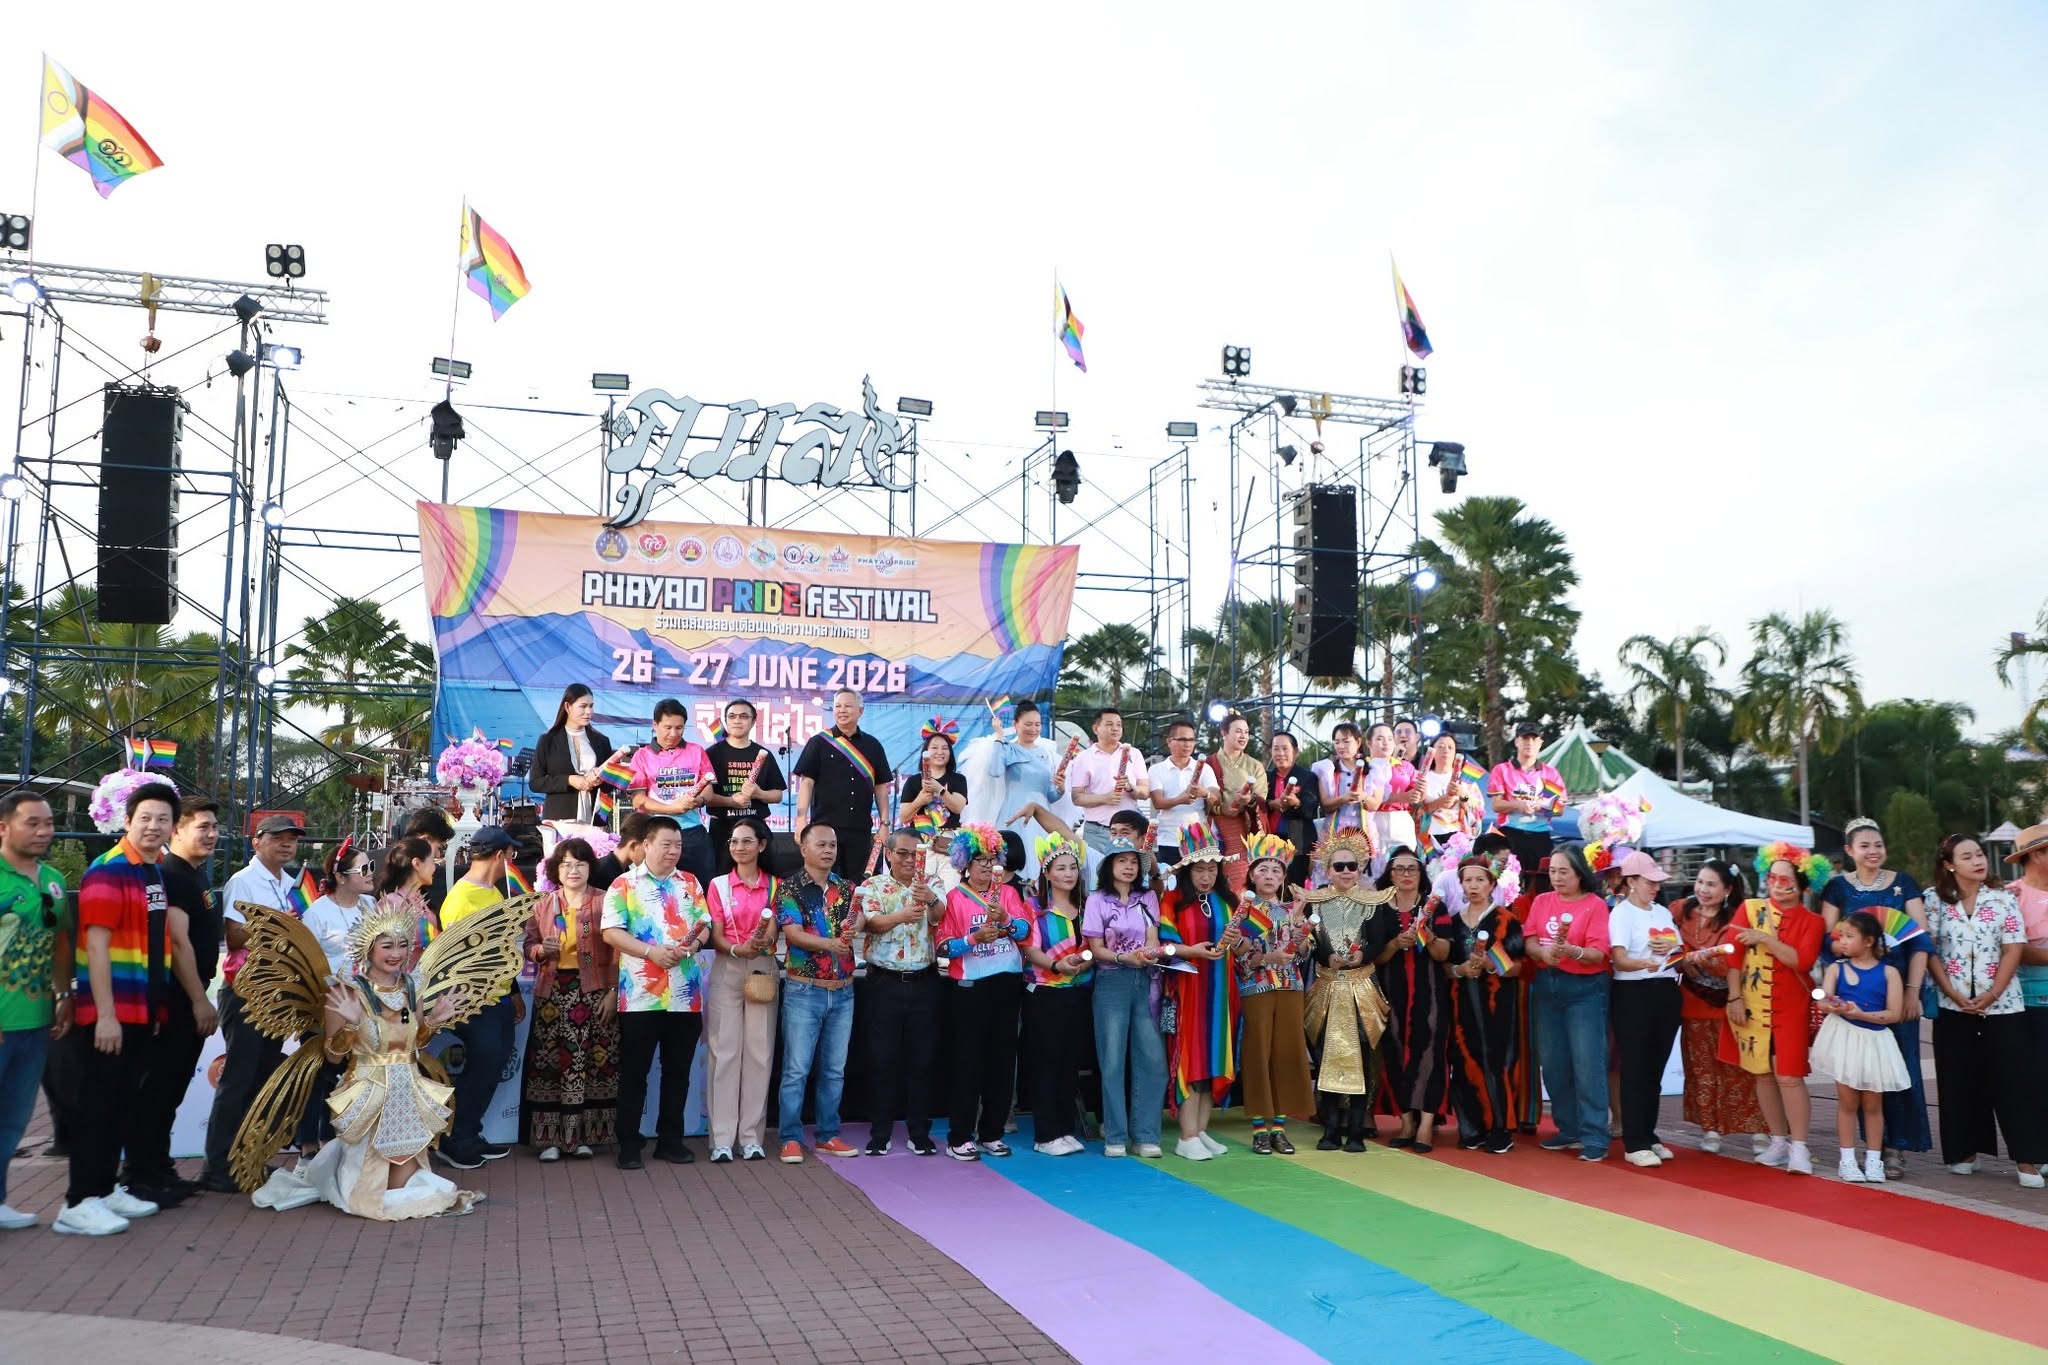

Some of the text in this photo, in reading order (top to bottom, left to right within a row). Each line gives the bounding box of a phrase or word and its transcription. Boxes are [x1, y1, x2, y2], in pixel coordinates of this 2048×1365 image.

[583, 571, 938, 623] PHAYAO PRIDE FESTIVAL
[612, 648, 653, 683] 26
[688, 652, 729, 686] 27
[738, 654, 818, 690] JUNE
[826, 658, 906, 692] 2026
[659, 767, 678, 776] LIVE
[972, 914, 988, 925] LIV
